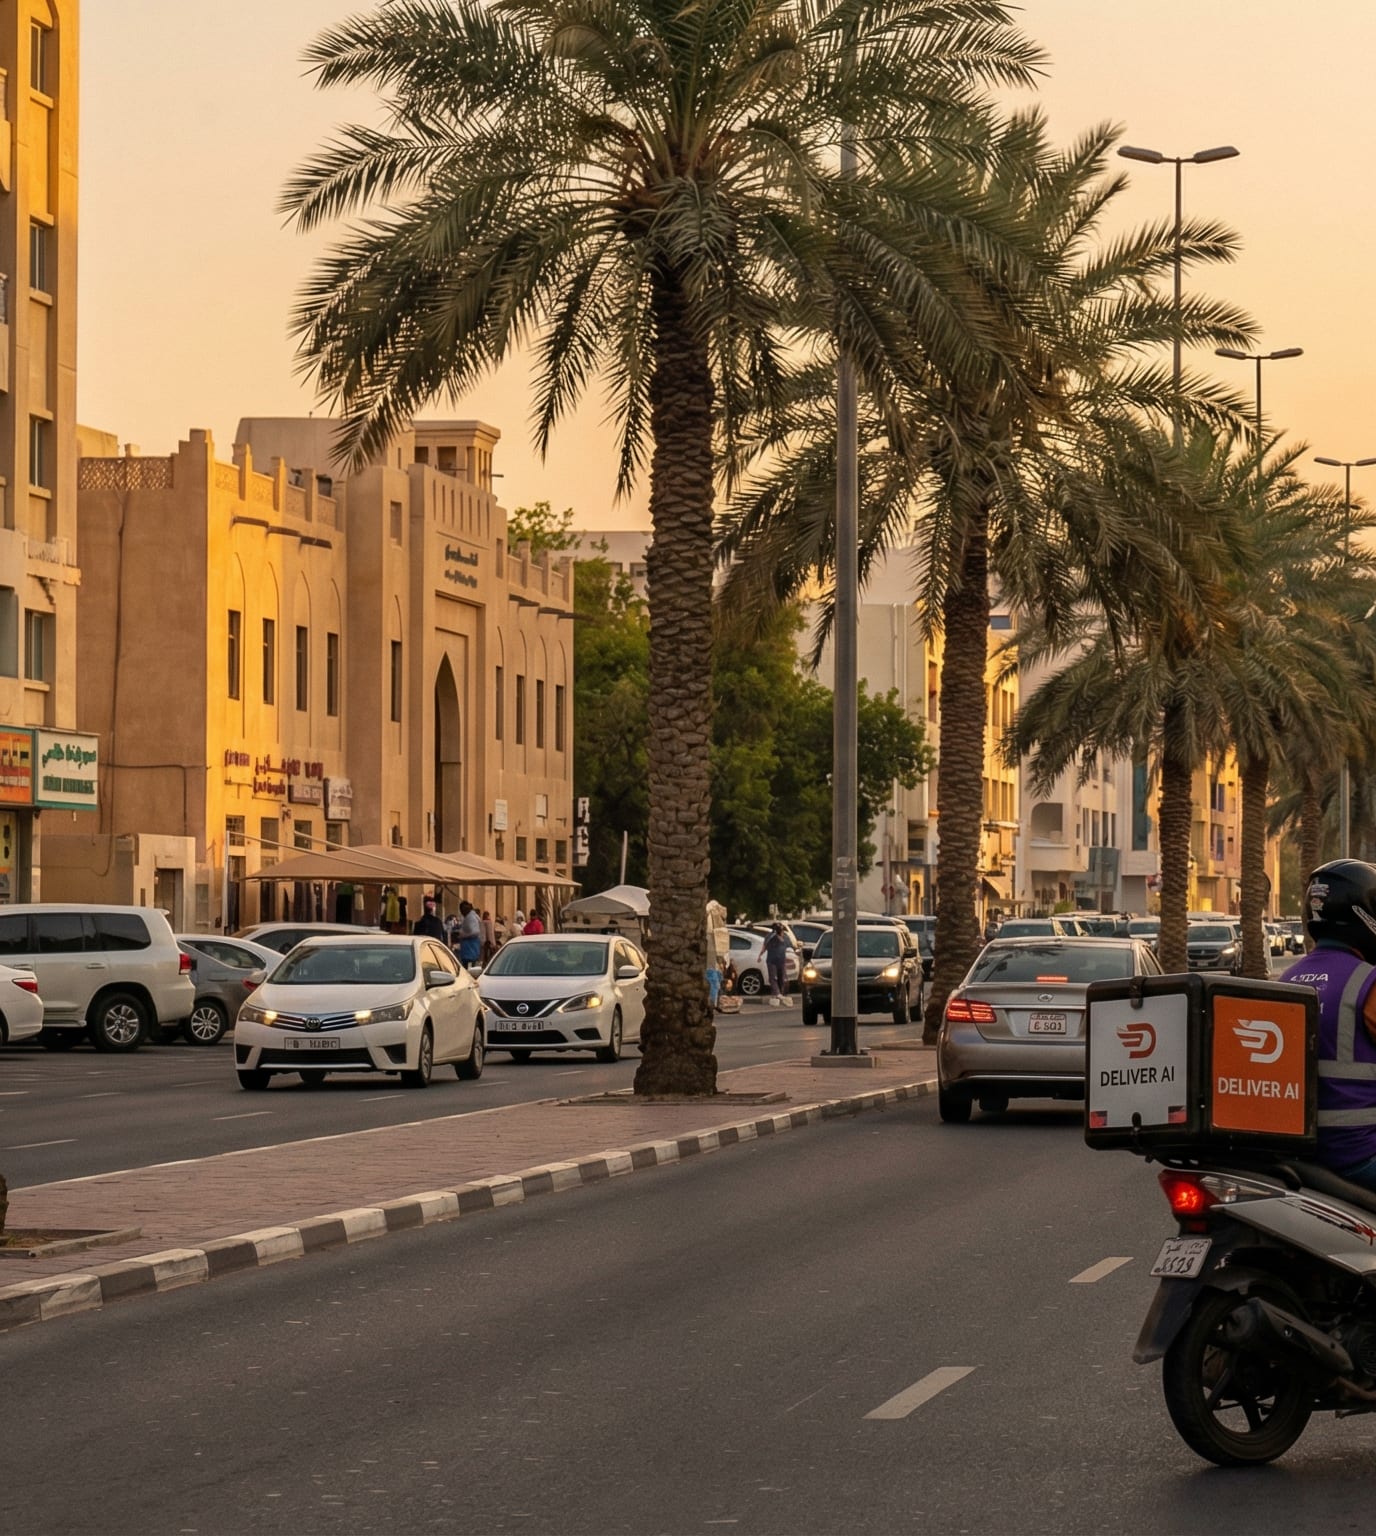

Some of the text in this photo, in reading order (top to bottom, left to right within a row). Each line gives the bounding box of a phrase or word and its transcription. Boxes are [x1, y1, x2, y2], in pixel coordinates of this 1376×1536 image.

[1100, 1065, 1175, 1087] DELIVER AI
[1217, 1076, 1299, 1100] DELIVER AI
